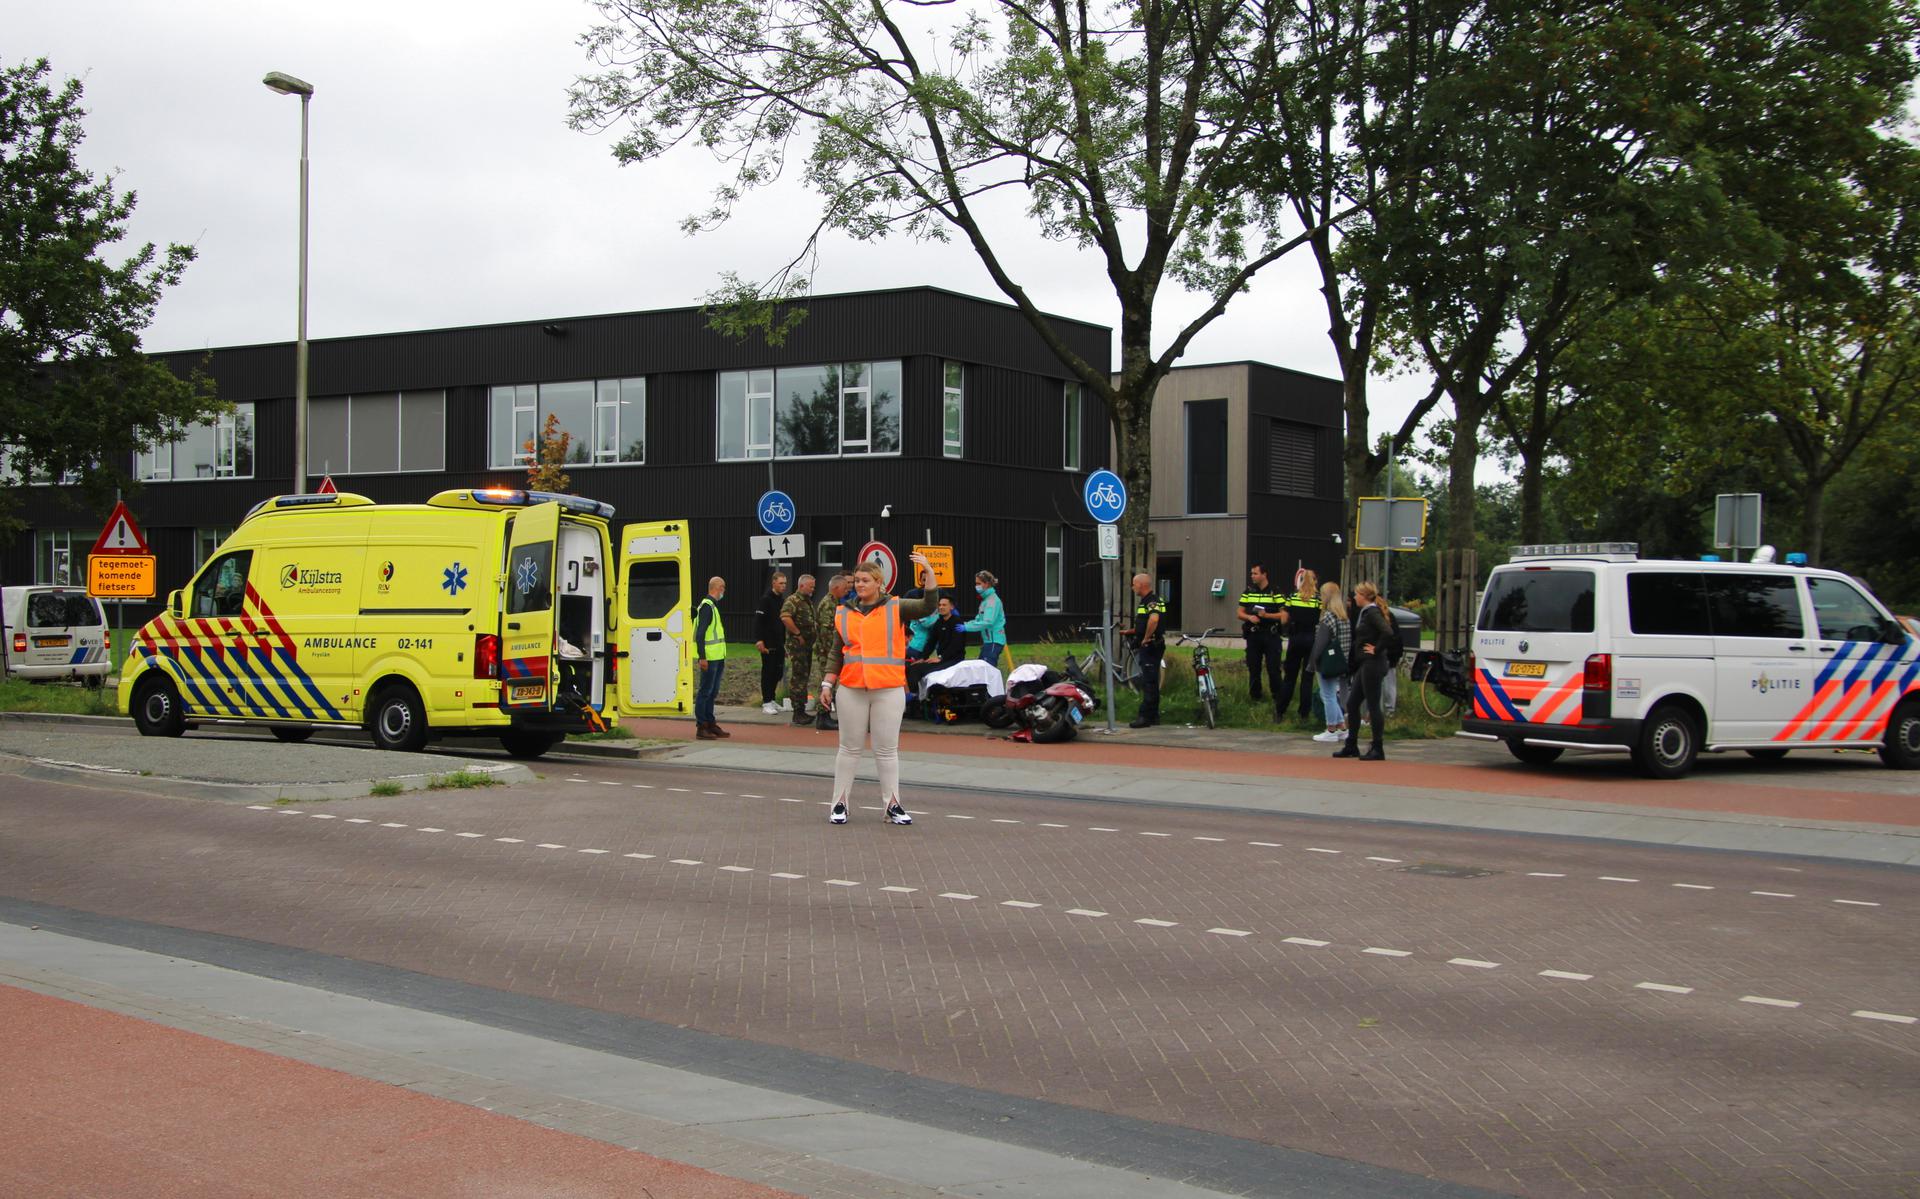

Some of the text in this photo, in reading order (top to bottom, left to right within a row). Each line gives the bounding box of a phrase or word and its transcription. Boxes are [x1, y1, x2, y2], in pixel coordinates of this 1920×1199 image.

[98, 559, 149, 570] tegemoet-
[98, 571, 142, 580] komende
[299, 569, 342, 588] Kijlstra
[98, 582, 136, 591] fietsers
[304, 637, 377, 649] AMBULANCE
[398, 638, 433, 649] 02-141
[511, 642, 541, 651] AMBULANCE
[1480, 638, 1505, 646] POLITIE
